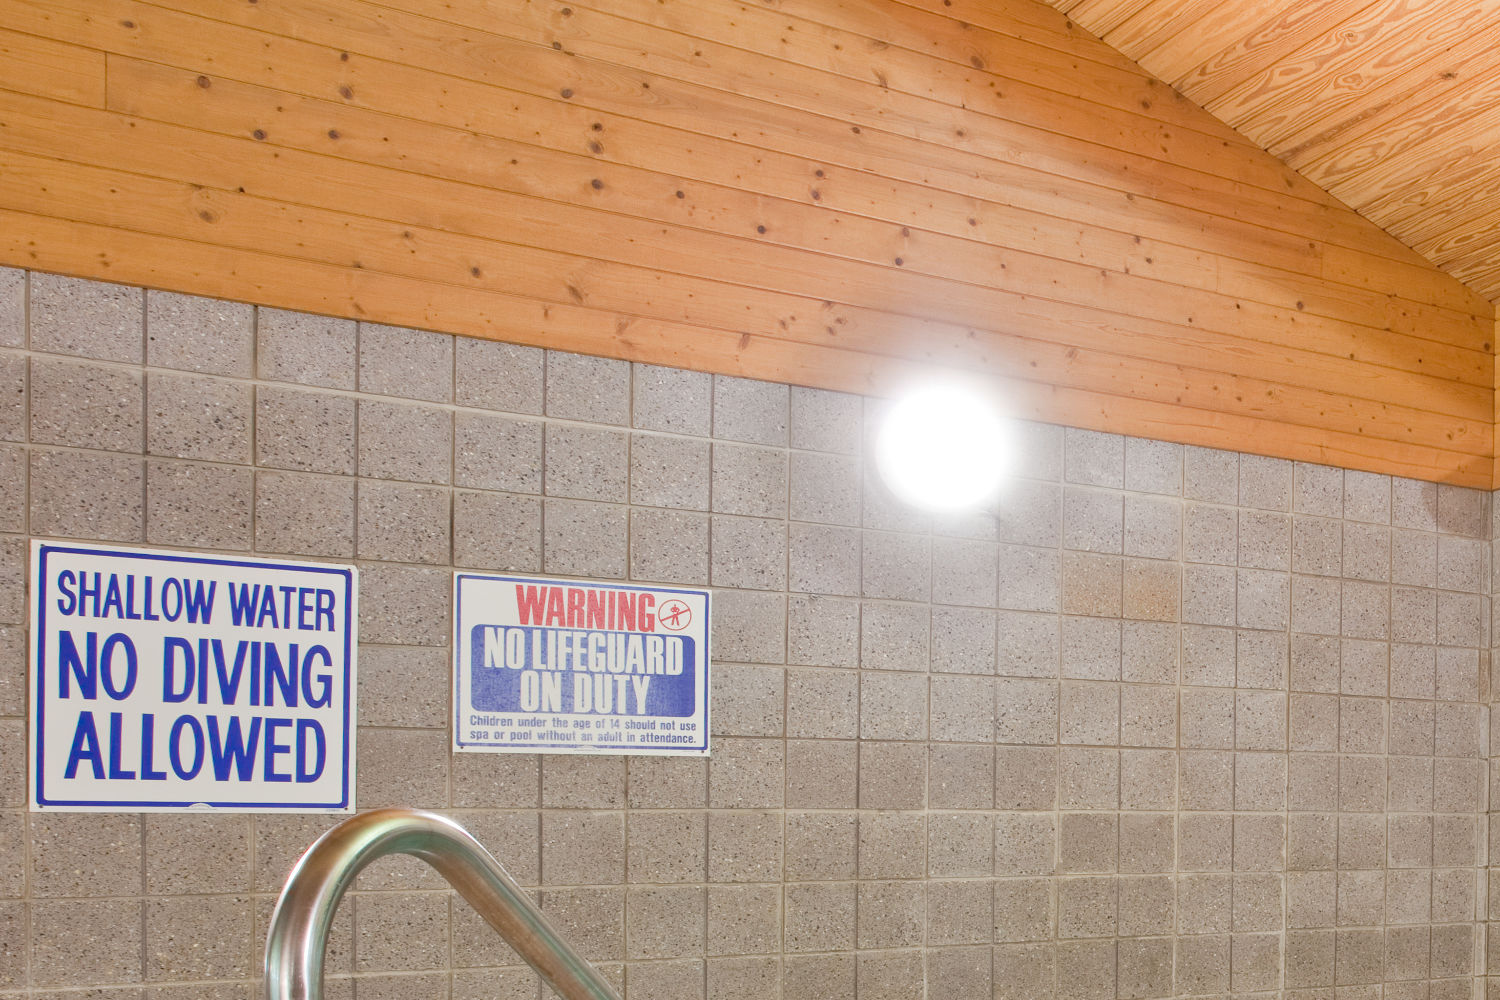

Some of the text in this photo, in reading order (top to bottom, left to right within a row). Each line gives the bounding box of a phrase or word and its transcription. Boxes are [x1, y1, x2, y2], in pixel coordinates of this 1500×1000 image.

[57, 569, 336, 632] SHALLOW WATER
[515, 584, 656, 633] WARNING
[58, 630, 333, 709] NO DIVING
[483, 626, 684, 676] NO LIFEGUARD
[520, 670, 651, 715] ON DUTY
[470, 714, 697, 731] Children under the age of 14 should not use
[470, 729, 697, 744] spa or pool without an adult in attendance.
[63, 711, 327, 784] ALLOWED
